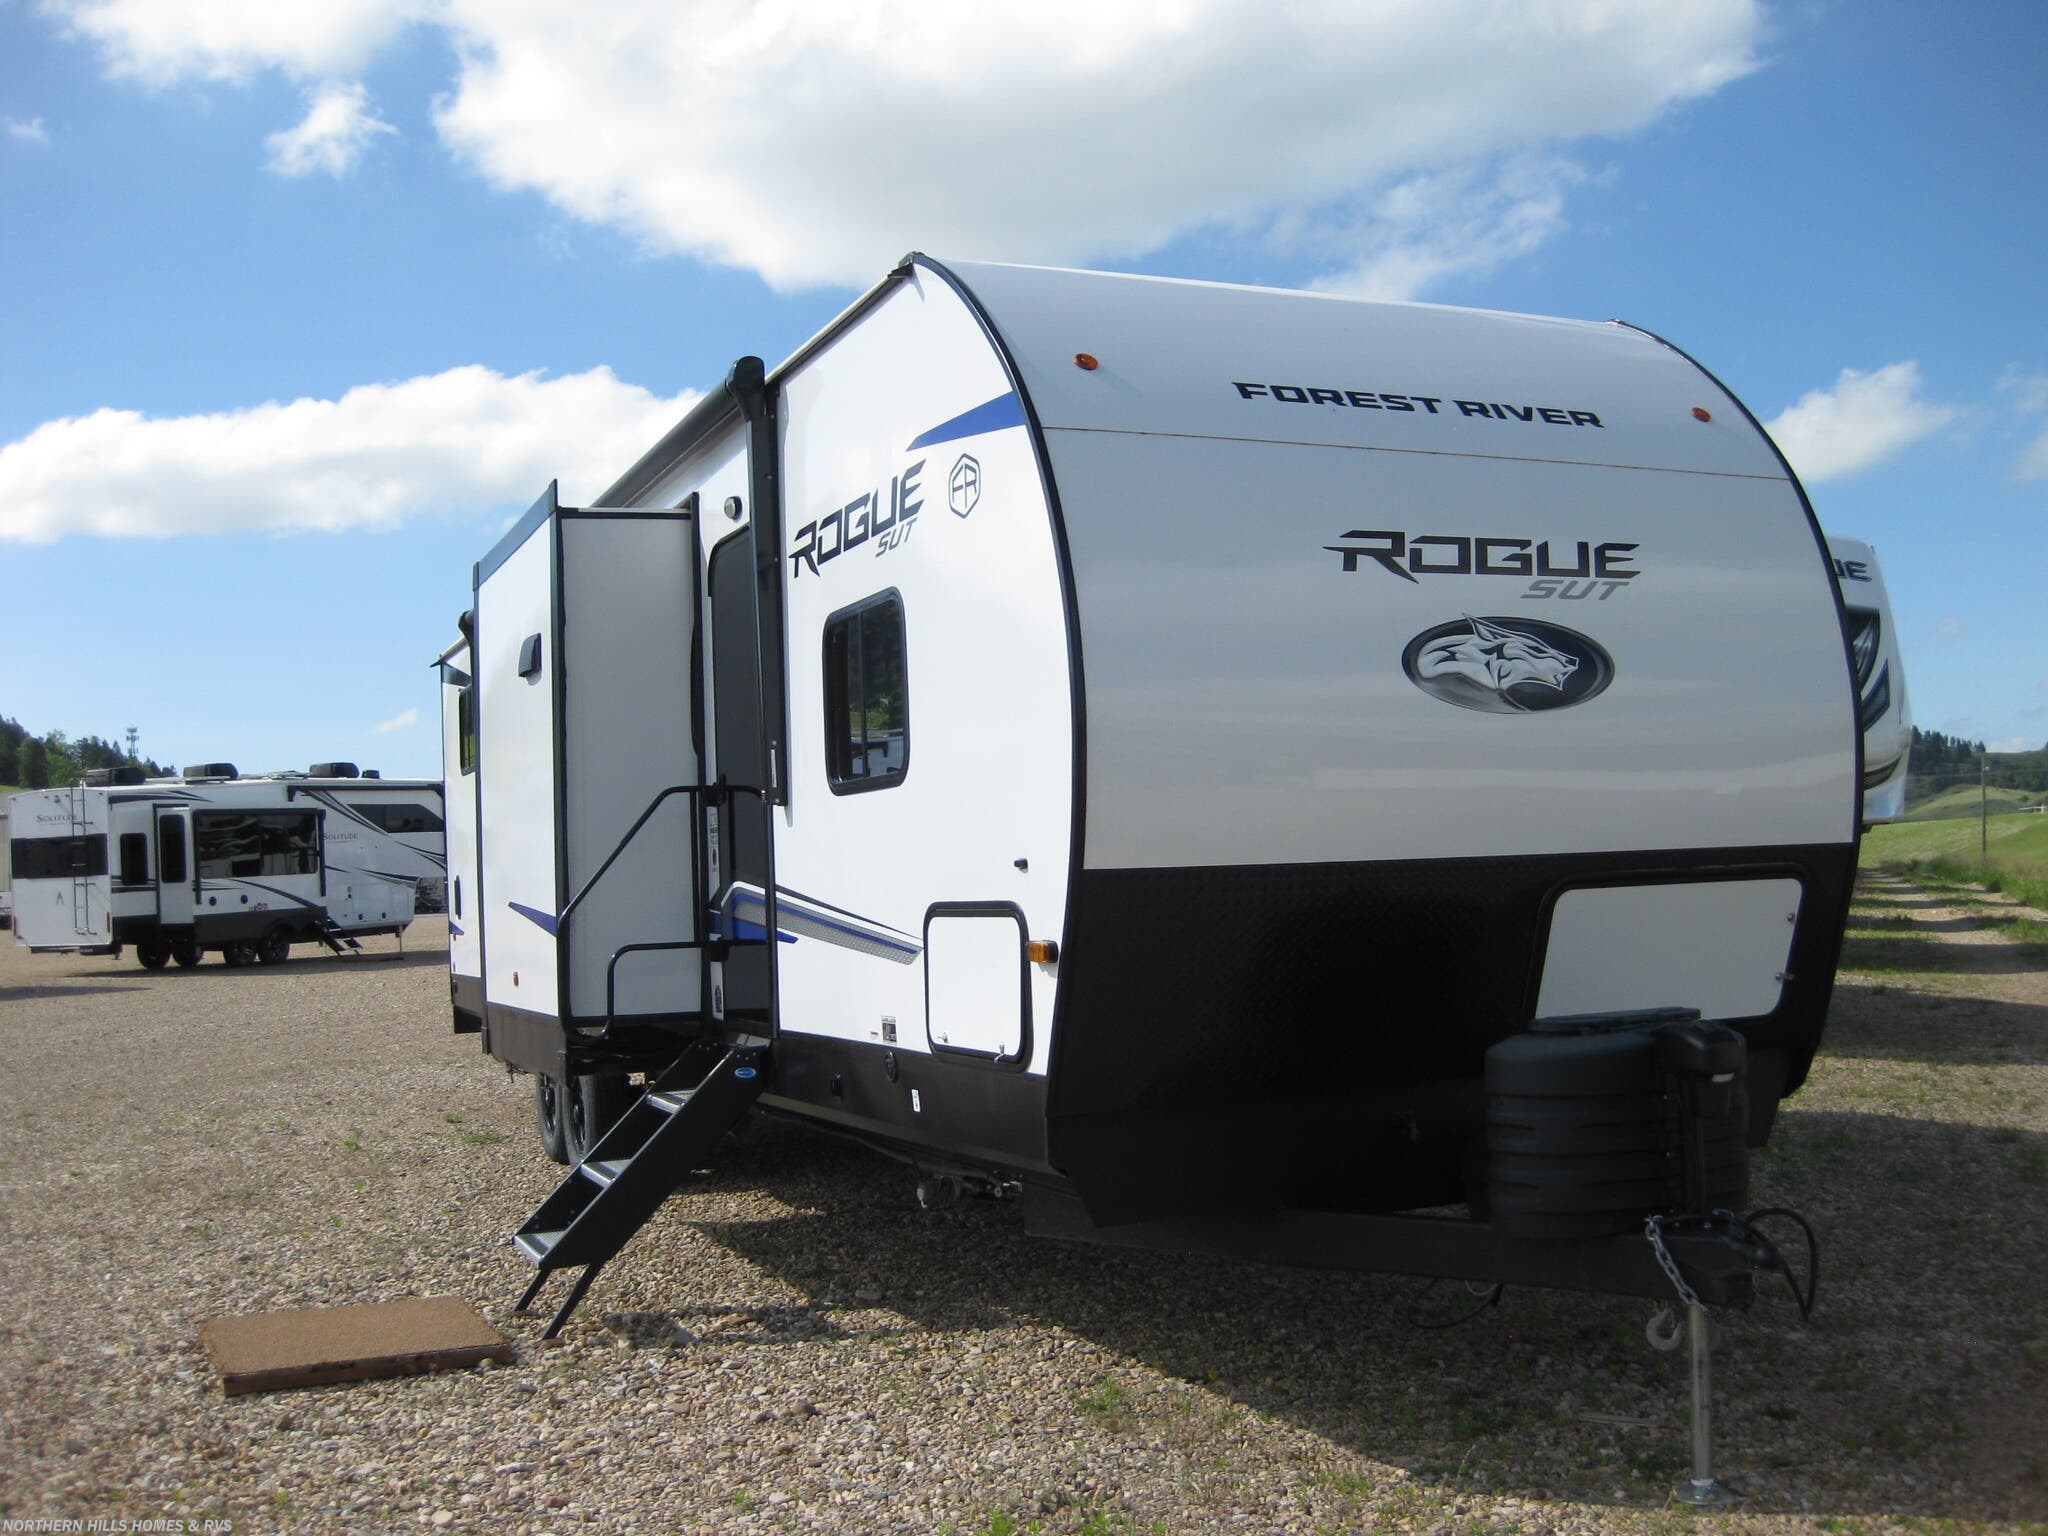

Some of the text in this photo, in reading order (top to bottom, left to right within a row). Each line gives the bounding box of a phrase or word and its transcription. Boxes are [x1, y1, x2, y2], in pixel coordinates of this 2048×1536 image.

[1232, 382, 1606, 428] FOREST RIVER
[788, 459, 927, 579] ROGUE
[875, 517, 918, 558] SUT
[1323, 530, 1641, 584] ROGUE
[1520, 580, 1630, 601] SUT
